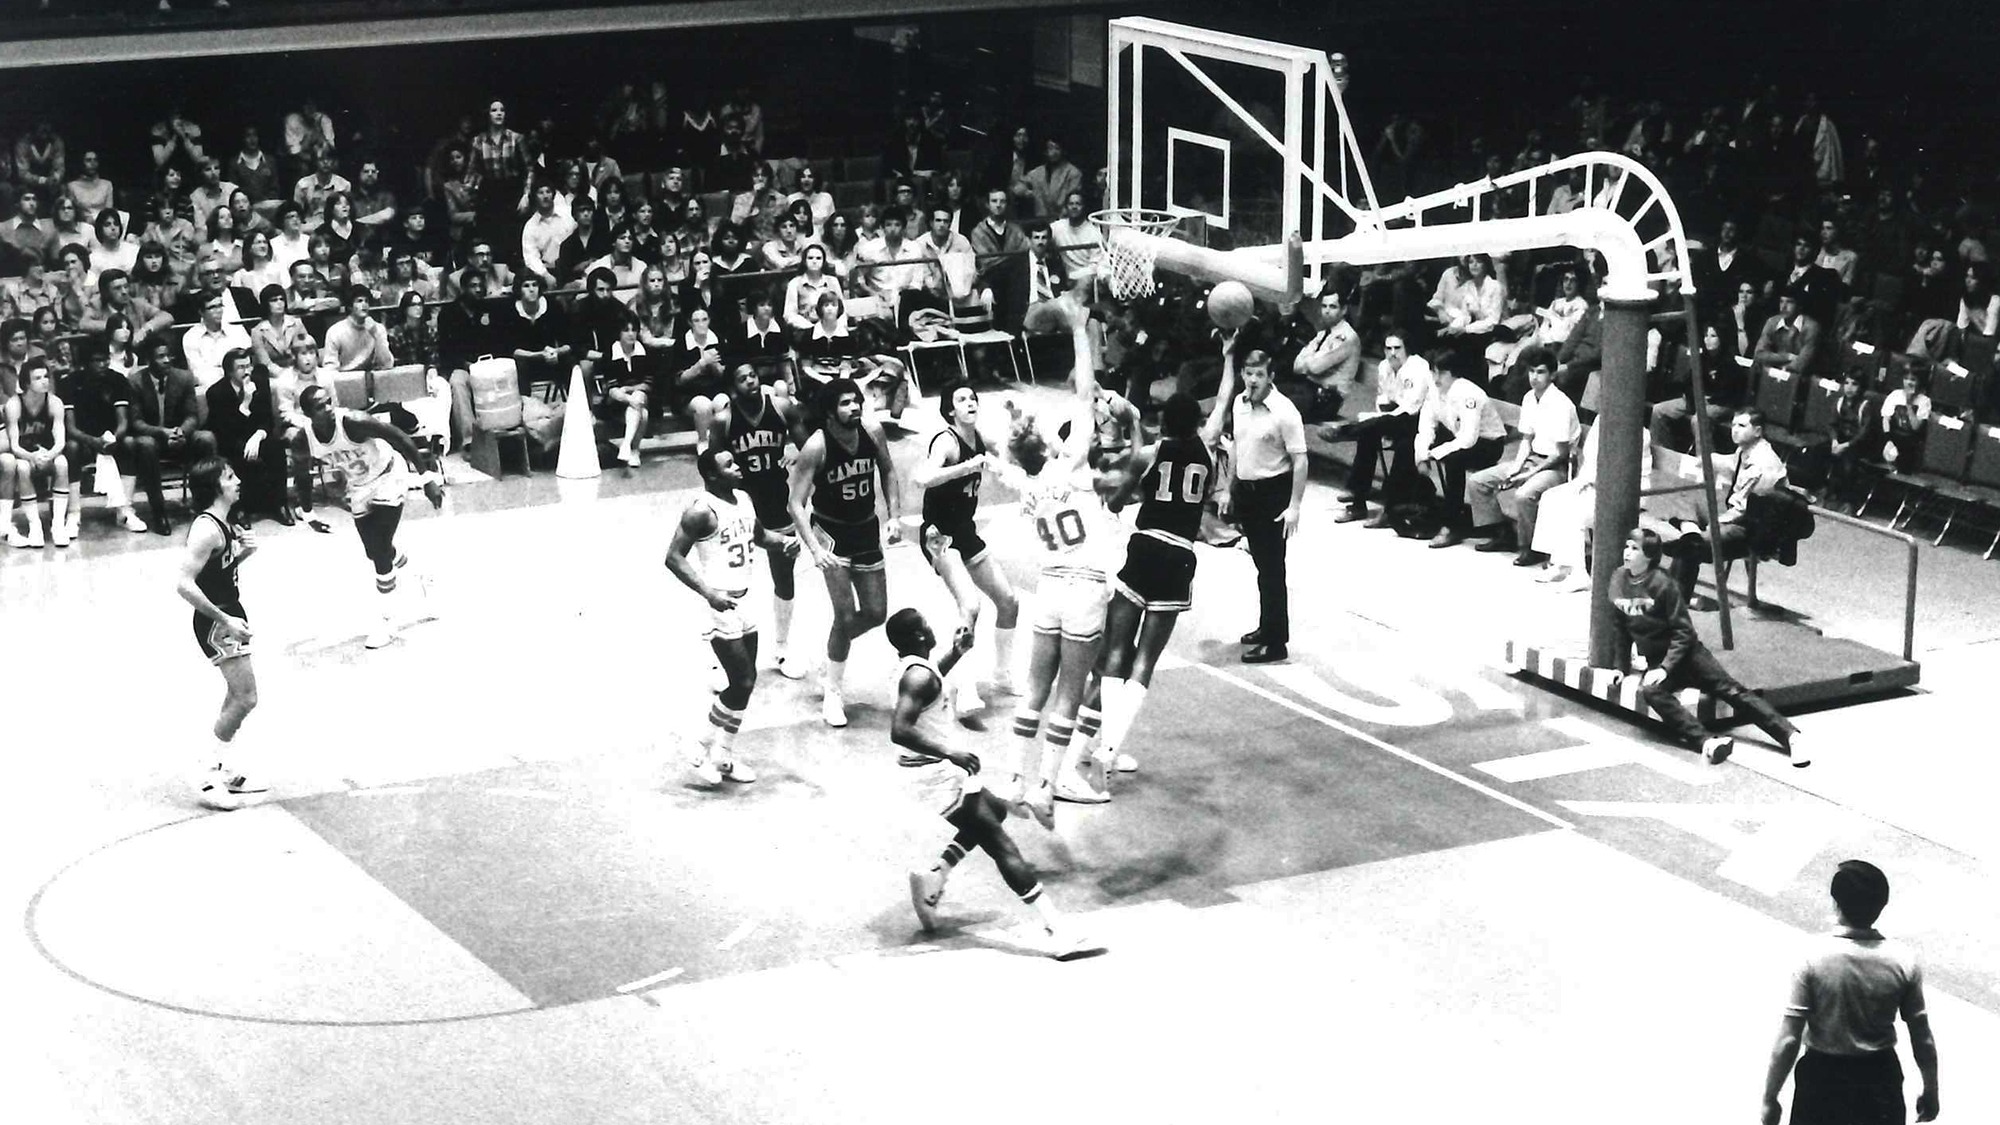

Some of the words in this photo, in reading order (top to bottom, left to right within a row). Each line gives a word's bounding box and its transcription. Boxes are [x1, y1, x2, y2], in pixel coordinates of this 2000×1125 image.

[748, 453, 771, 472] 31
[842, 479, 870, 500] 50
[1155, 461, 1209, 503] 10
[1036, 509, 1086, 551] 40
